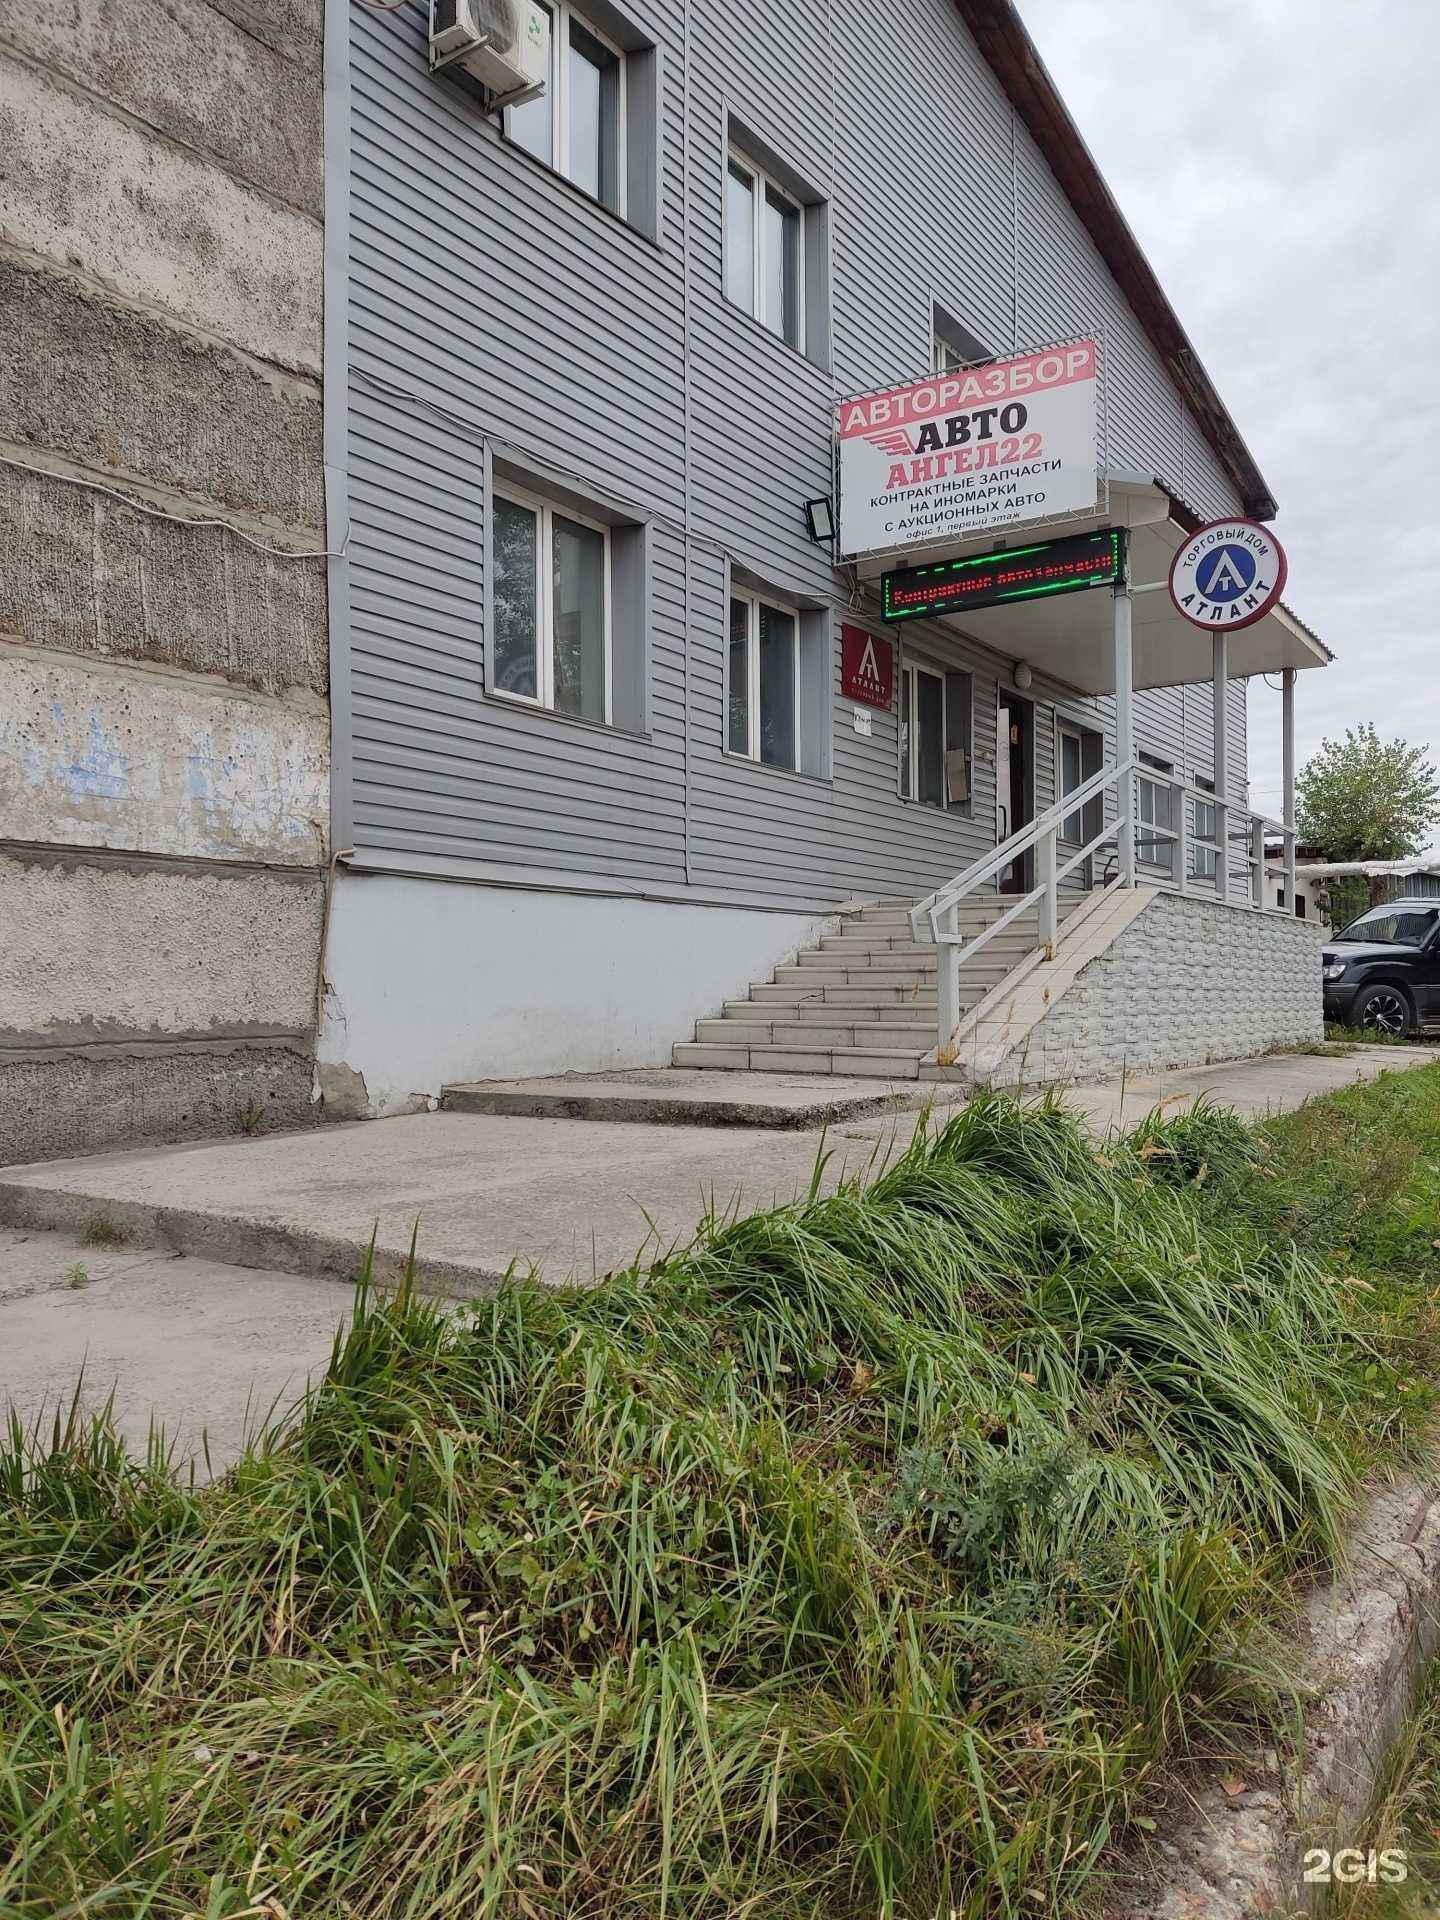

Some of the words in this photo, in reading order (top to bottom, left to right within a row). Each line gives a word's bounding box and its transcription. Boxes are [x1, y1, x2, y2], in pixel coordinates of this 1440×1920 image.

[844, 348, 1089, 432] АВТОРАЗБОР
[914, 402, 1029, 455] АВТО
[885, 433, 1043, 490] АНГЕЛ22
[870, 476, 975, 508] КОНТРАКТНЫЕ
[980, 459, 1062, 486] ЗАПЧАСТИ
[910, 499, 930, 514] НА
[934, 483, 1017, 509] ИНОМАРКИ
[884, 519, 895, 532] С
[898, 501, 1000, 531] АУКЦИОННЫХ
[1004, 491, 1046, 510] АВТО
[906, 527, 934, 540] офис
[947, 516, 987, 532] первый
[990, 512, 1022, 525] этаж
[1184, 528, 1245, 568] ТОРГОВЫЙ
[1244, 532, 1269, 557] ДОМ
[1181, 580, 1272, 621] АТЛАНТ
